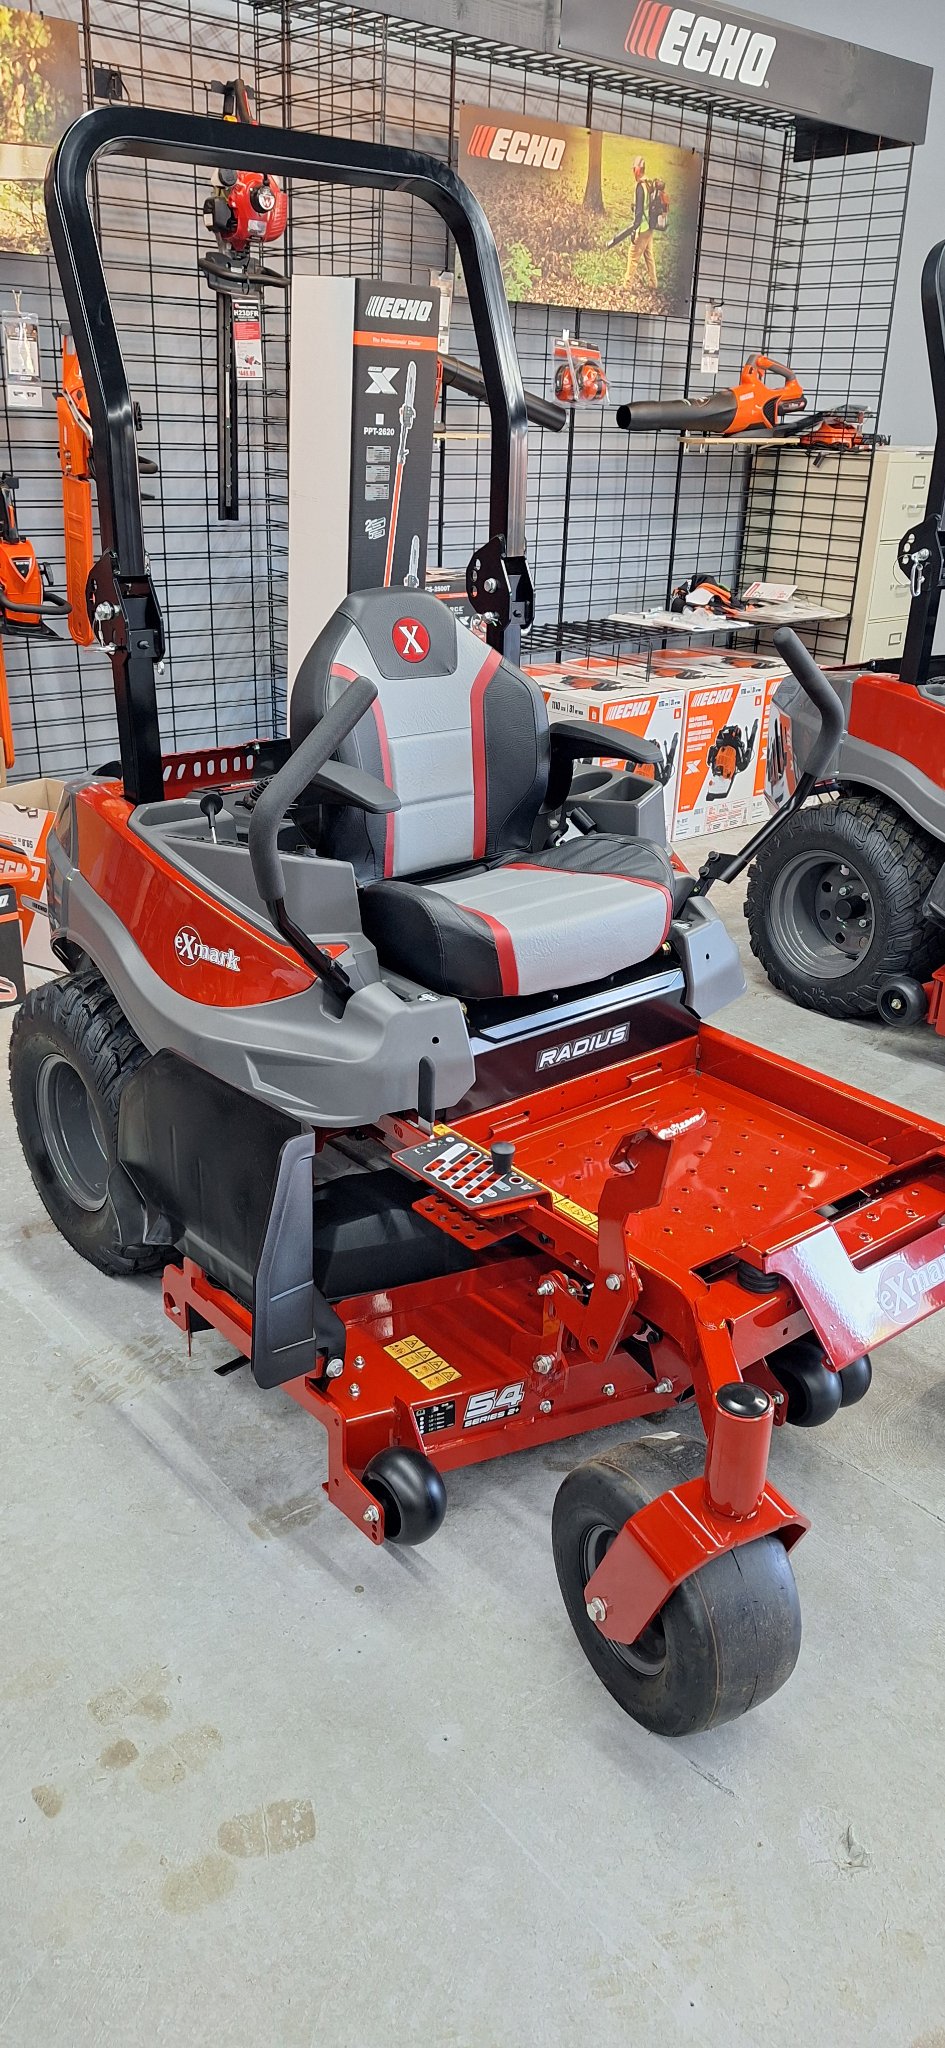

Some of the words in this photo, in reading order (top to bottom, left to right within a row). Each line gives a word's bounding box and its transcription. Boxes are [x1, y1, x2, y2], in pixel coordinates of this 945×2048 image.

[658, 8, 777, 87] ECHO
[489, 127, 566, 170] ECHO
[379, 296, 433, 322] ECHO
[363, 426, 395, 436] PPT-2620
[398, 625, 425, 654] X
[615, 700, 649, 719] ECHO
[698, 687, 734, 706] ECHO
[174, 931, 241, 972] eXmark
[539, 1024, 628, 1069] RADIUS
[465, 1381, 525, 1419] 54
[463, 1410, 506, 1428] SERIES
[507, 1406, 520, 1416] 2+
